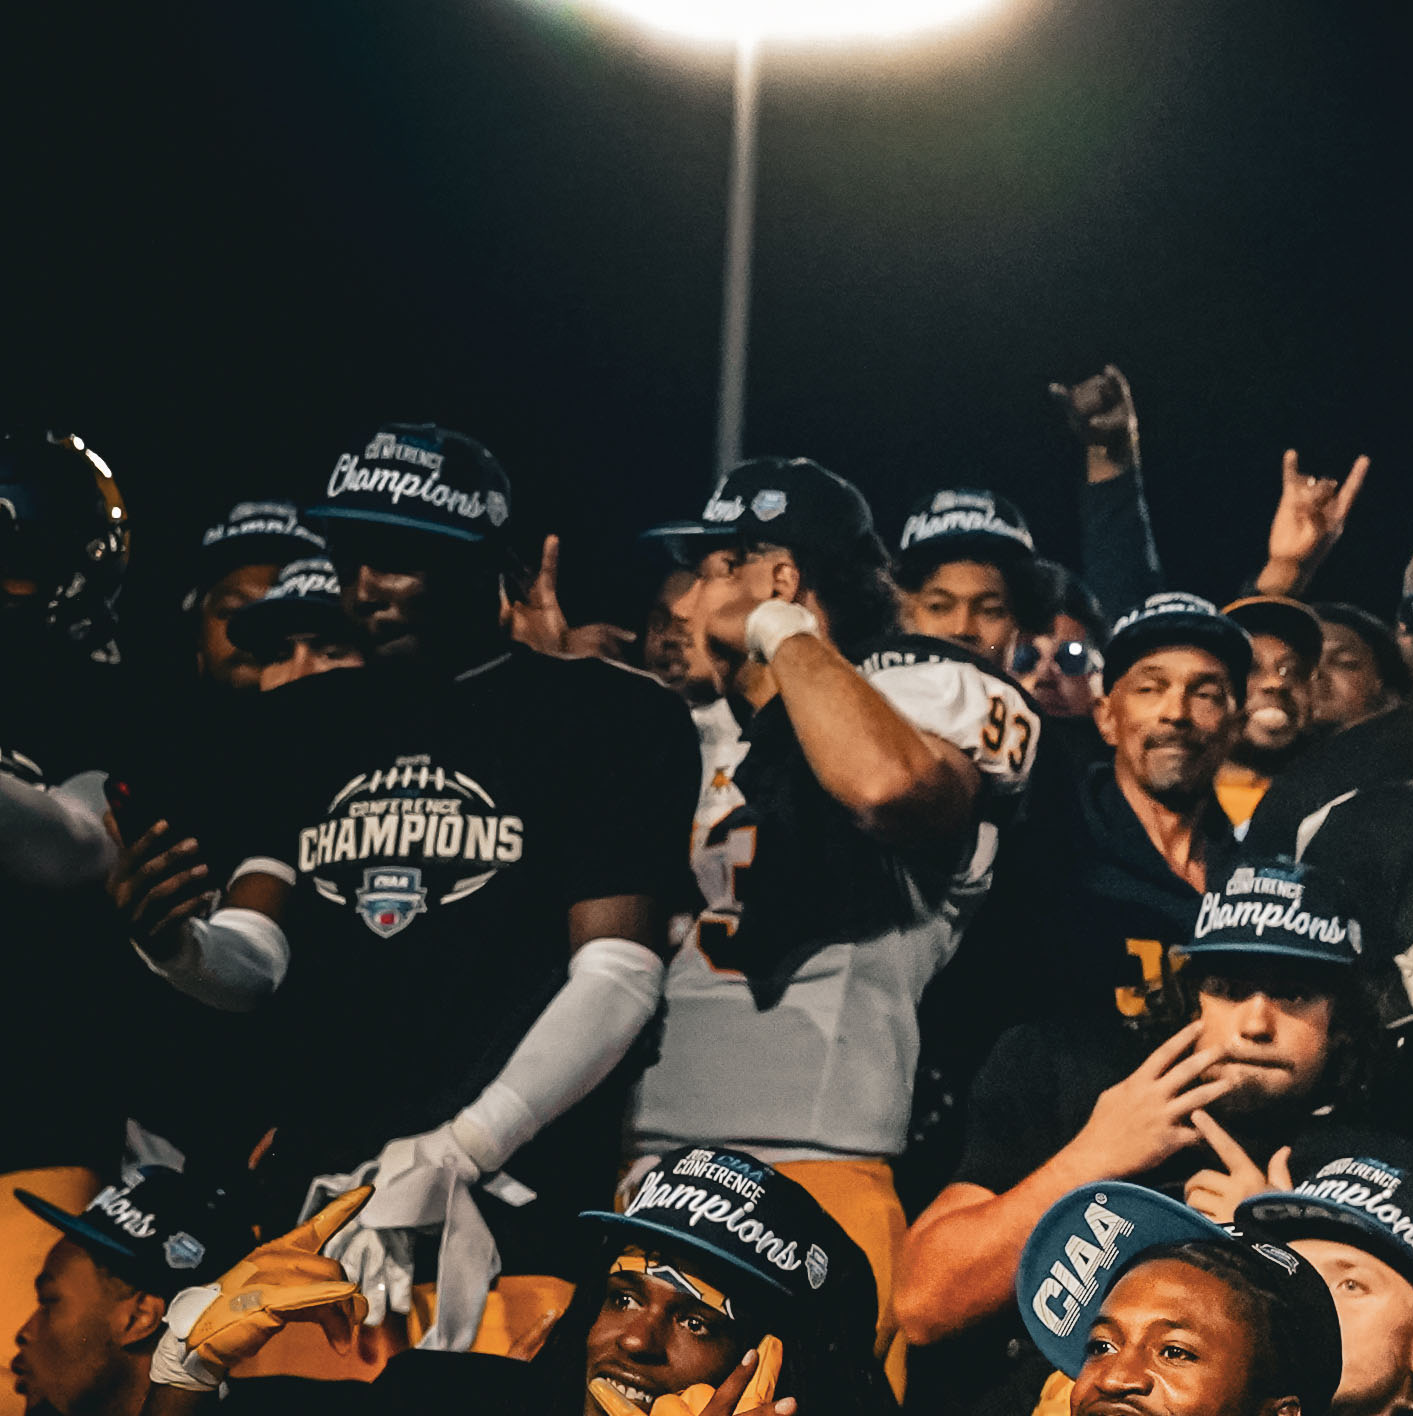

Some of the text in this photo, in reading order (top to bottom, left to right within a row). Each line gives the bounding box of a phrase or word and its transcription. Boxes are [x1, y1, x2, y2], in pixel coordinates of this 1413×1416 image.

[327, 453, 486, 518] Champions
[298, 815, 524, 873] CHAMPIONS
[1194, 892, 1346, 944] Champions
[672, 1158, 766, 1205] CONFERENCE
[623, 1171, 802, 1271] Champions
[1032, 1198, 1135, 1338] CIAA
